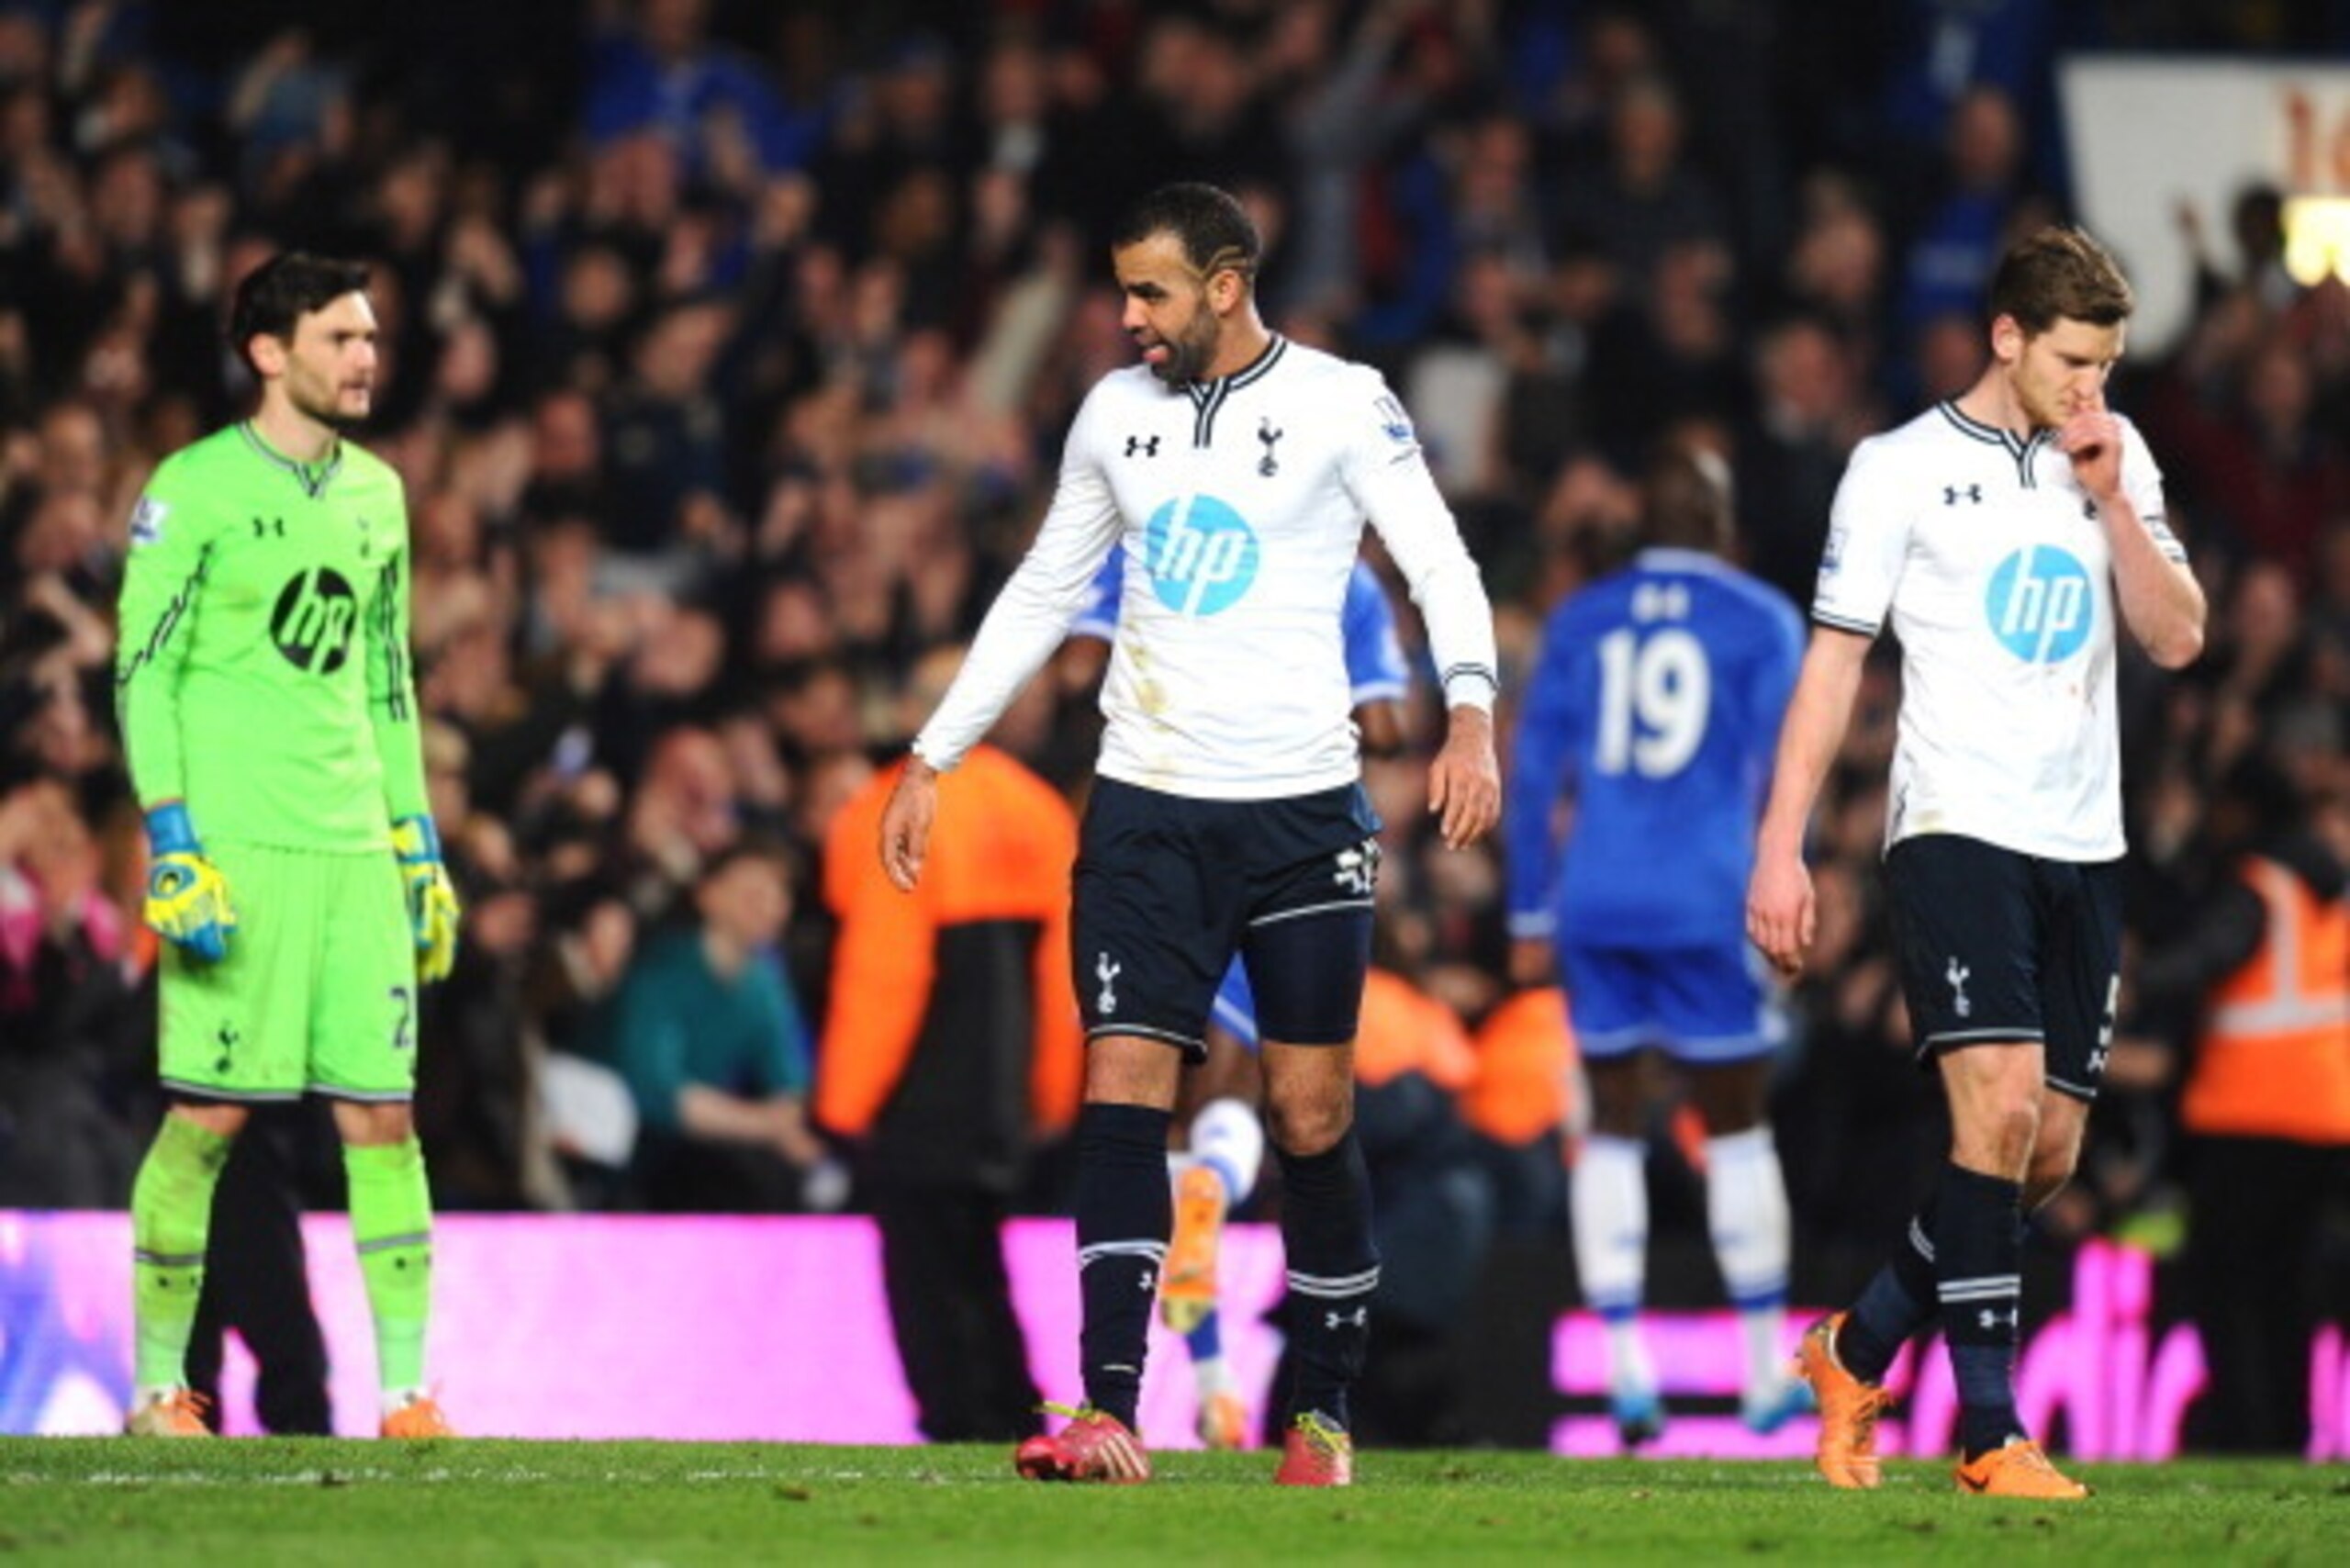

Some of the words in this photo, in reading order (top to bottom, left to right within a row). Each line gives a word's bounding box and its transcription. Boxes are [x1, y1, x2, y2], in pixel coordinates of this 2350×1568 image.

[1154, 493, 1248, 621] hp
[1999, 543, 2086, 665] hp
[277, 566, 353, 676] hp
[1595, 626, 1713, 780] 19
